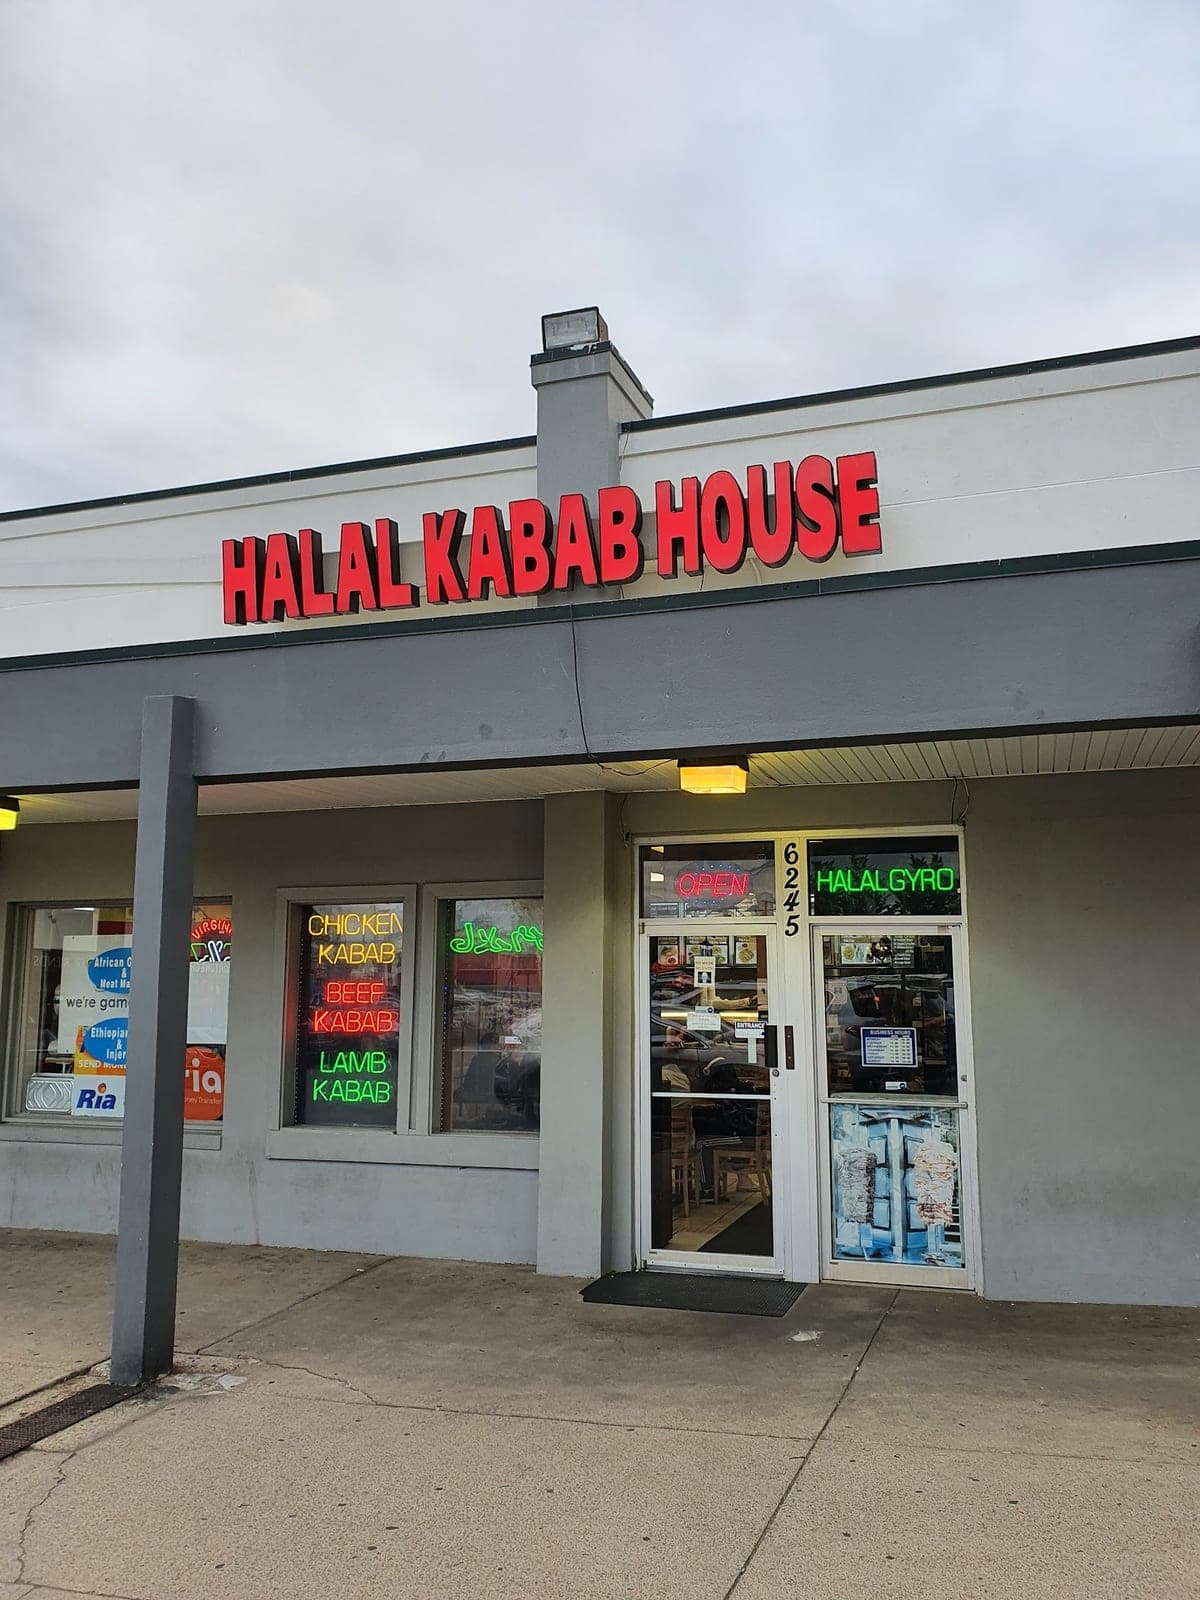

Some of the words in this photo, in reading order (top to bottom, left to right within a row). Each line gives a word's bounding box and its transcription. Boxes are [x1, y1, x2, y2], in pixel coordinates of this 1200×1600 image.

[222, 518, 420, 626] HALAL
[423, 486, 645, 605] KABAB
[655, 451, 883, 579] HOUSE
[677, 871, 749, 898] OPEN
[816, 868, 888, 893] HALAL
[888, 867, 955, 892] GYRO
[307, 913, 404, 936] CHICKEN
[94, 956, 124, 968] African
[318, 942, 396, 965] KABAB
[100, 979, 118, 989] Meat
[121, 967, 127, 978] &
[66, 996, 96, 1008] we're
[327, 982, 385, 1004] BEEF
[313, 1010, 394, 1033] KABAB
[116, 1039, 123, 1049] &
[78, 1059, 102, 1068] SEND
[319, 1051, 387, 1074] LAMB
[76, 1082, 117, 1110] Ria
[312, 1079, 391, 1103] KABAB
